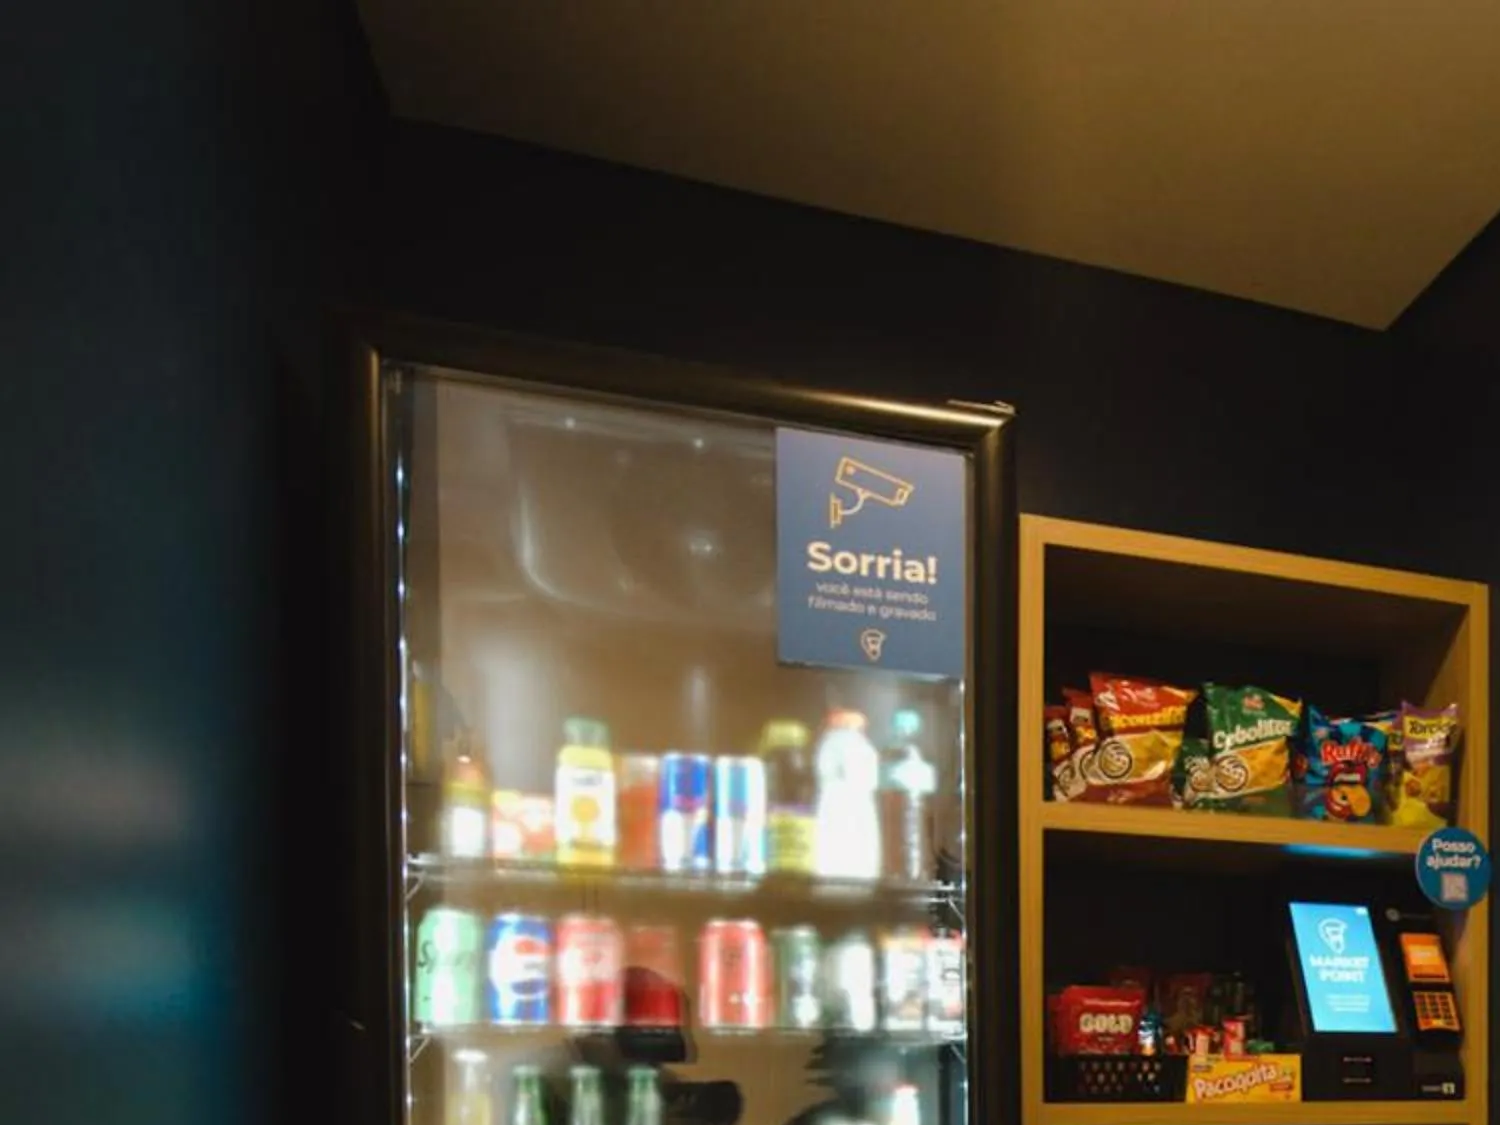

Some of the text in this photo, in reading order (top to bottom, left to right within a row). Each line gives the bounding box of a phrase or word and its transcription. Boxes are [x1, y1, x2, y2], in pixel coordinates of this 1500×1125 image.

[808, 541, 937, 584] Sorria!
[816, 582, 929, 605] você está sendo
[808, 595, 936, 621] filmado e gravado
[1432, 838, 1475, 852] Posso
[1426, 855, 1481, 870] ajudar?
[1080, 1013, 1133, 1034] GOLD
